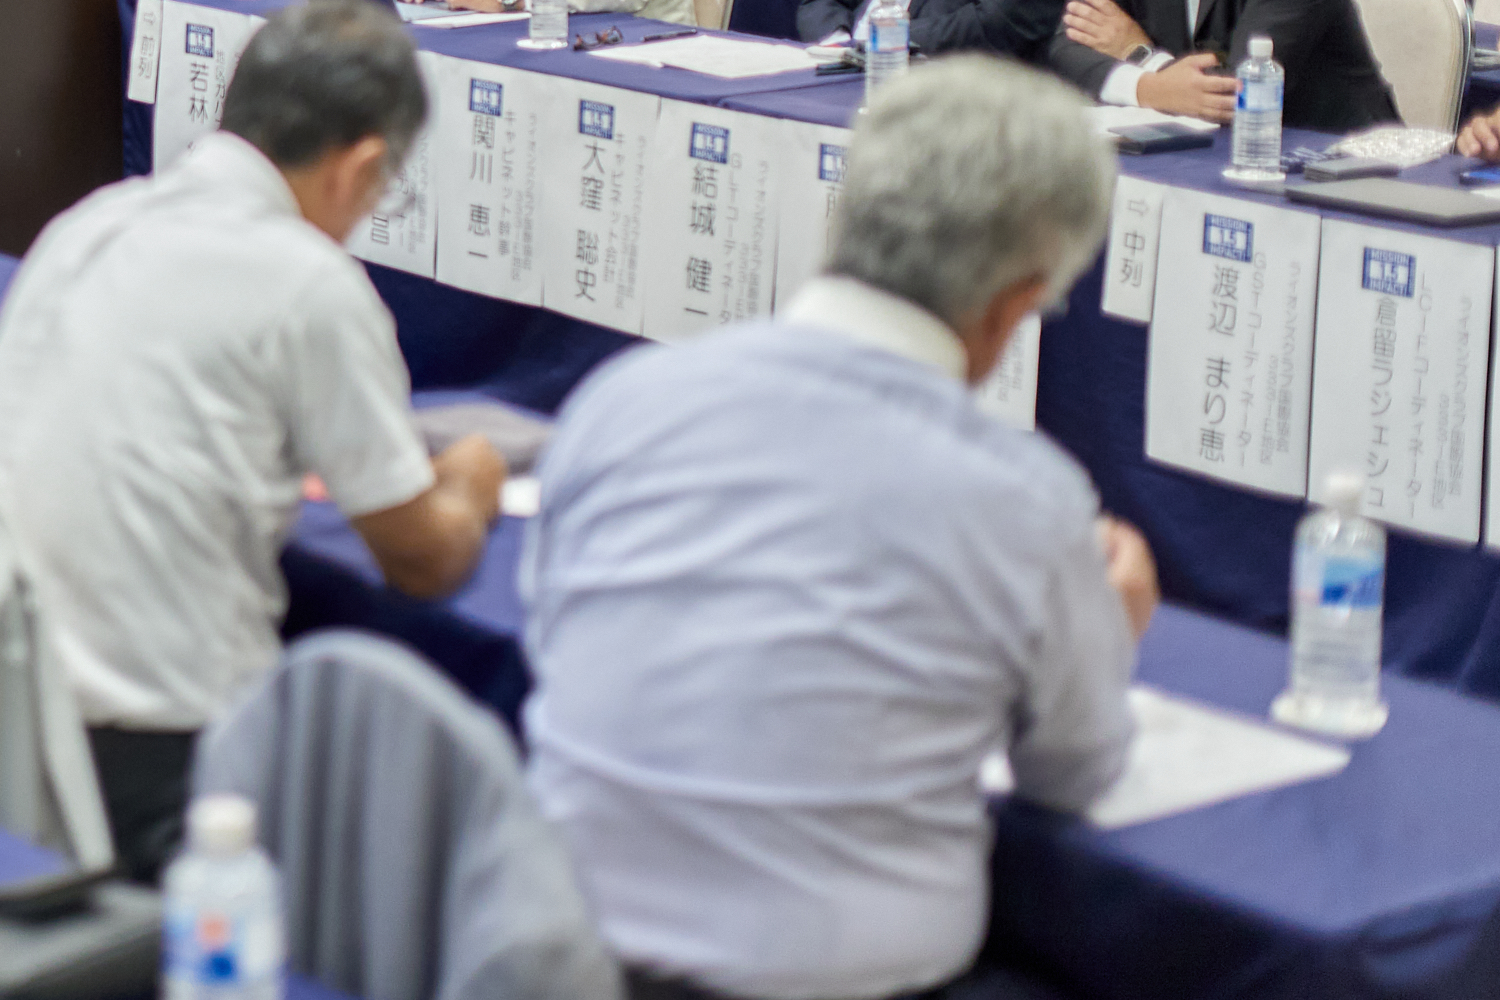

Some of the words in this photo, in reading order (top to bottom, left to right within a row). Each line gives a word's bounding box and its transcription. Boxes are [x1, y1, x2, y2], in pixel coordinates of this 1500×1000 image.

[189, 61, 209, 124] 若林
[469, 114, 495, 184] 関川
[467, 203, 491, 258] 恵一
[690, 163, 719, 237] 結城
[719, 153, 742, 326] GLTコーディネータ
[1119, 229, 1145, 288] 中列
[684, 256, 712, 316] 健一
[1208, 264, 1240, 337] 渡辺
[1200, 355, 1232, 463] まり恵
